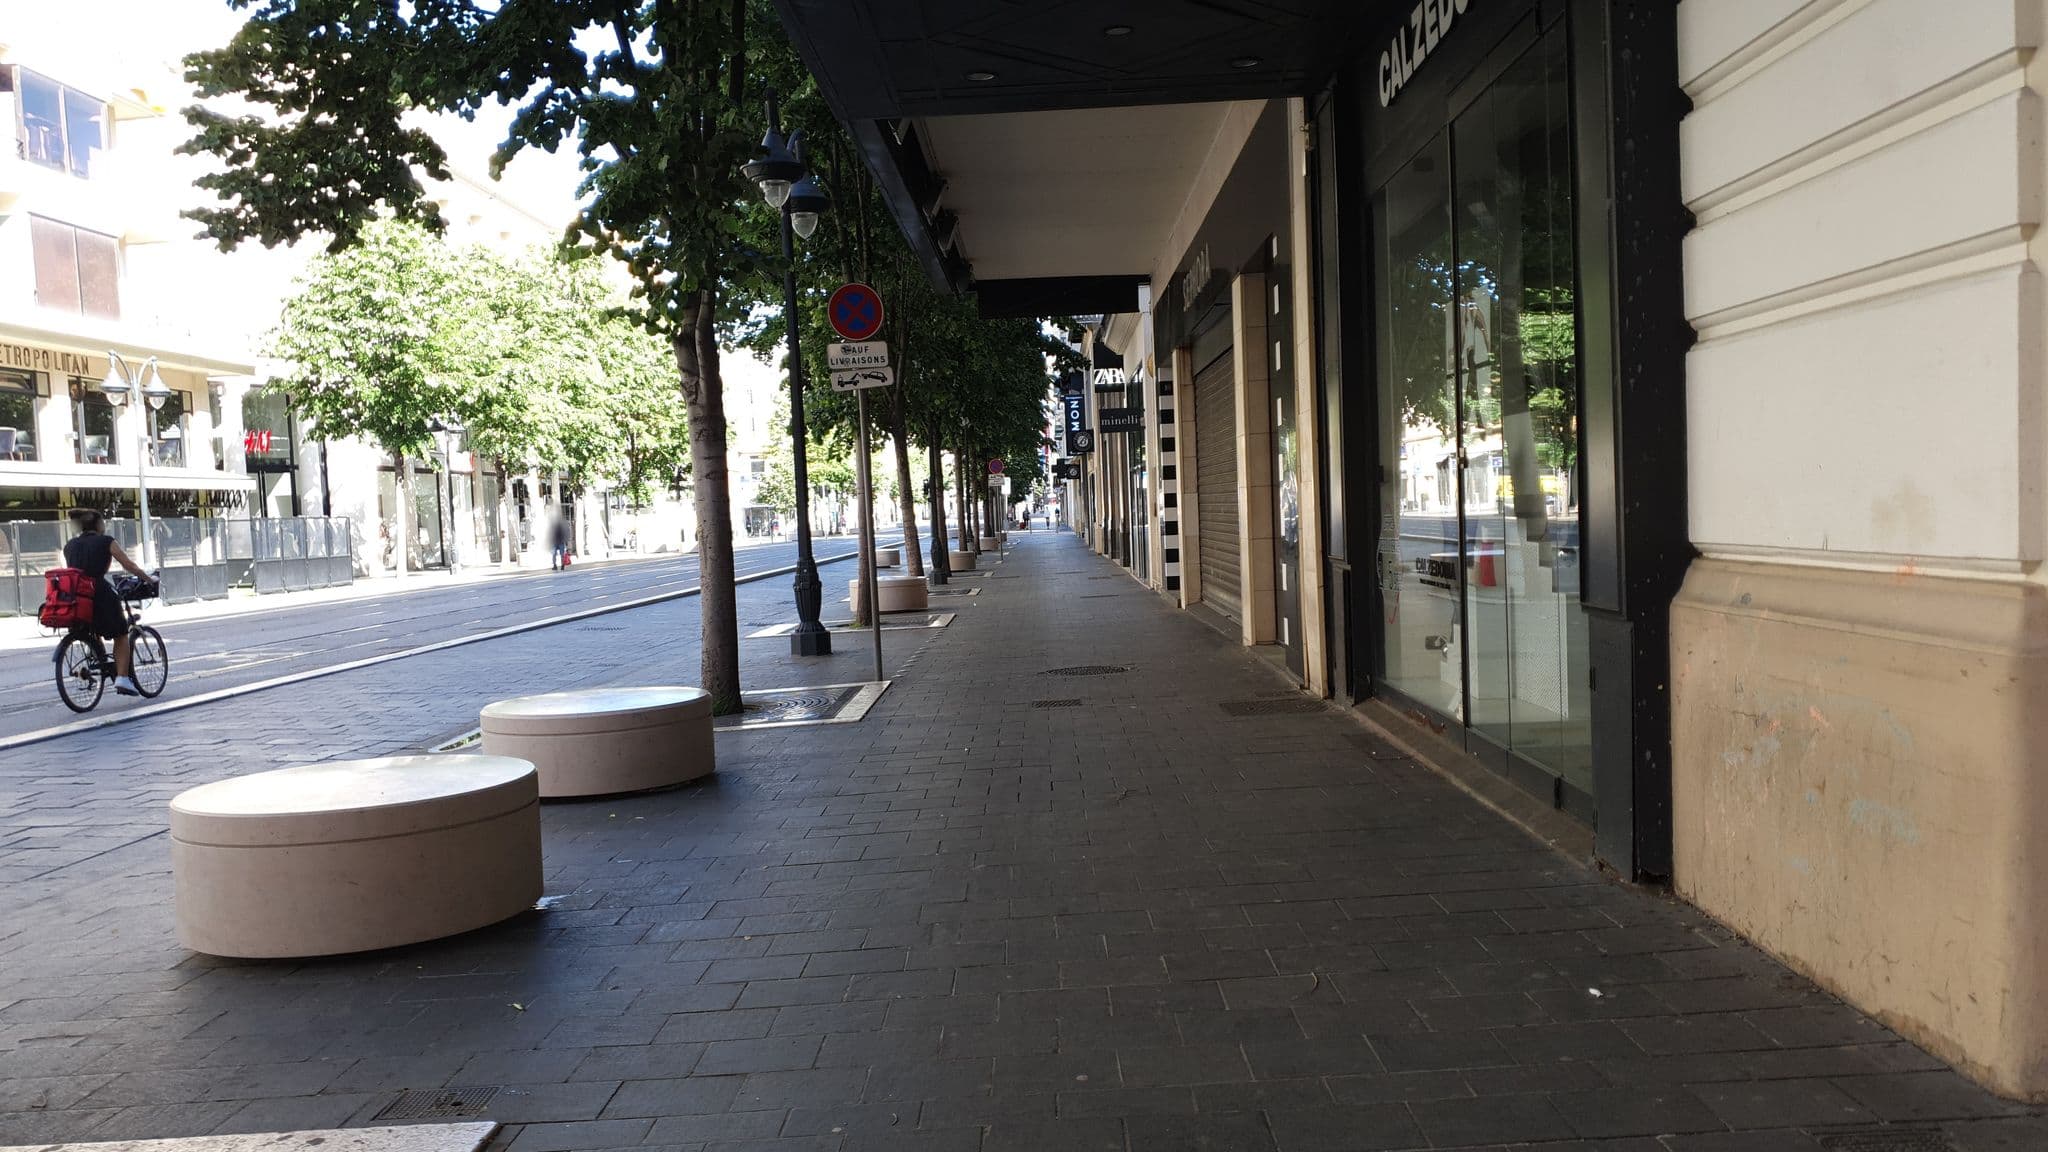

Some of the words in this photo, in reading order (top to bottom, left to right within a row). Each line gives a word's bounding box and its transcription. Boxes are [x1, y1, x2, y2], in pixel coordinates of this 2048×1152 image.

[1379, 0, 1469, 107] CALZED
[830, 356, 886, 365] LIVRAISONS
[1094, 368, 1126, 384] ZARA
[1101, 415, 1138, 426] minelli
